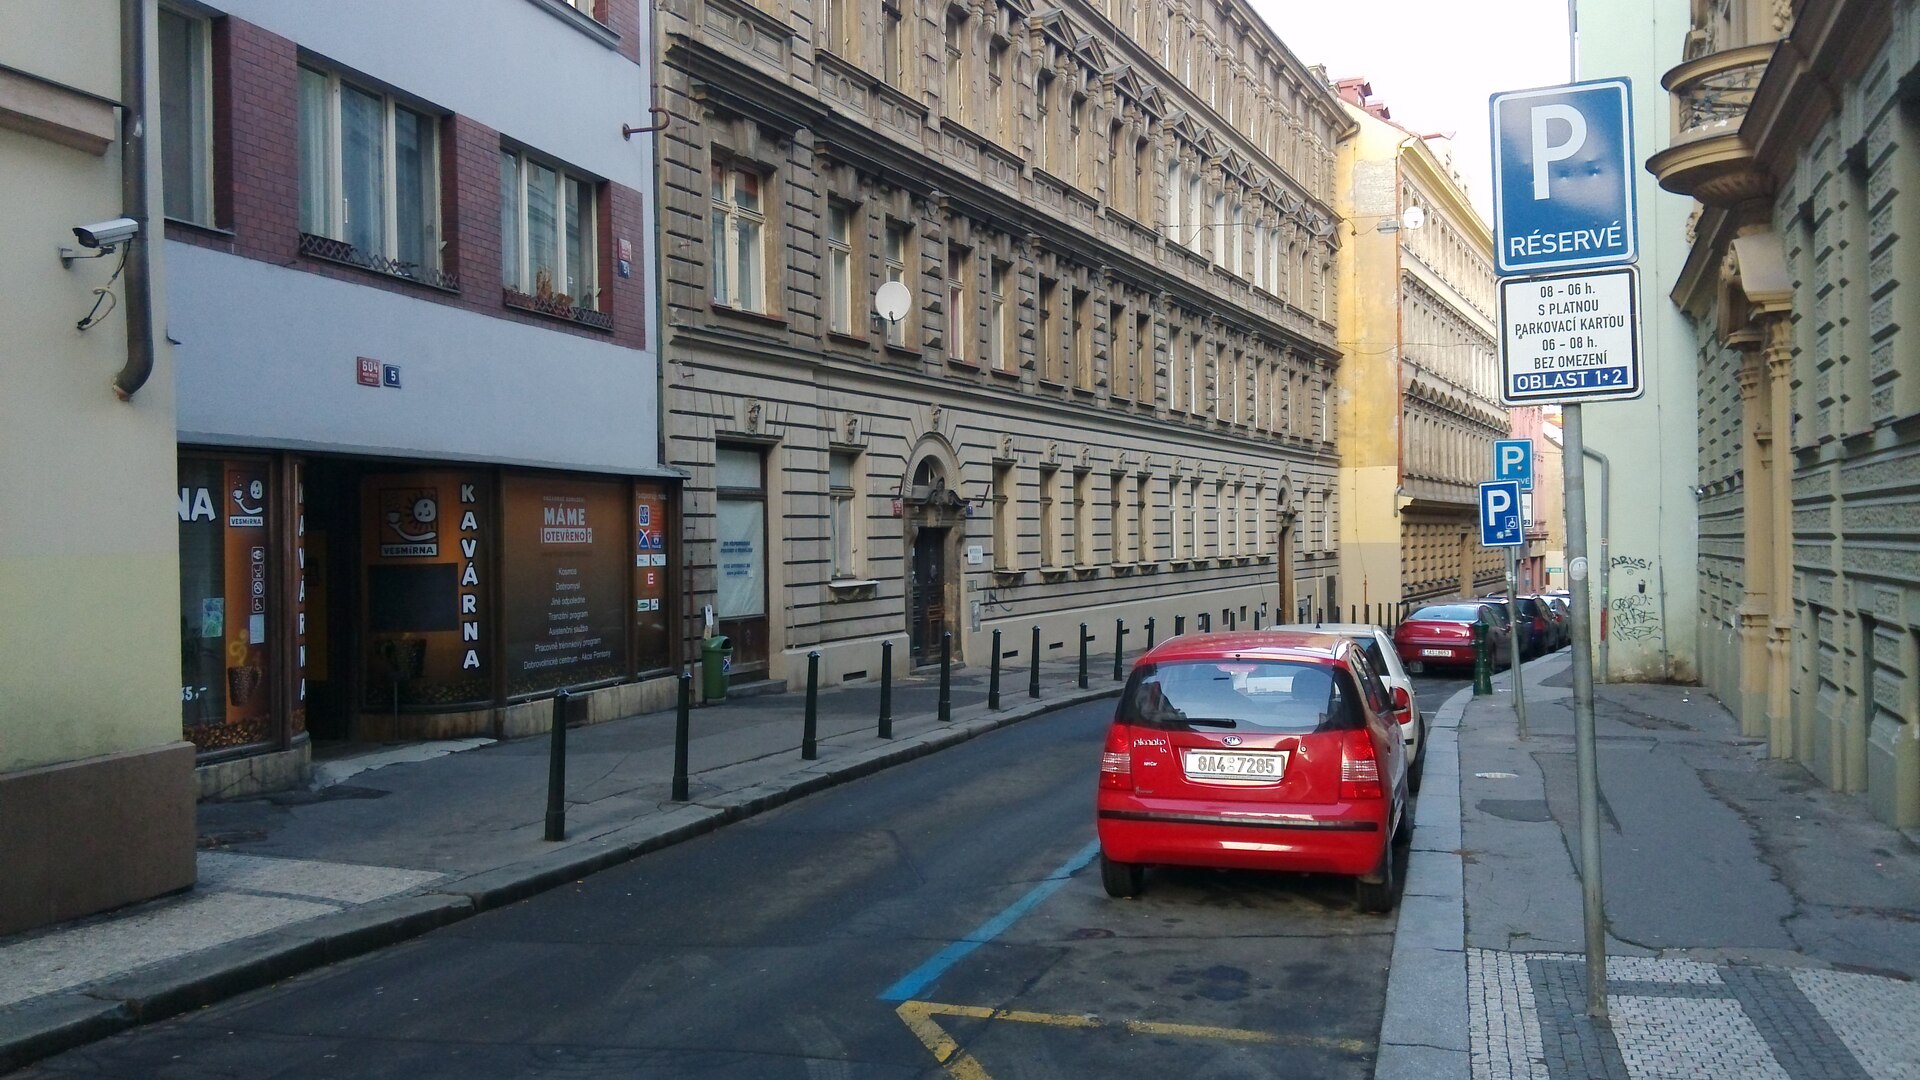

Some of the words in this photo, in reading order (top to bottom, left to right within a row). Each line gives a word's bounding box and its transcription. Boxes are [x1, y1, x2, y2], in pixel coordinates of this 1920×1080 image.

[1531, 103, 1587, 201] P
[1510, 221, 1622, 257] RÉSERVÉ
[1540, 286, 1554, 298] 08
[1567, 283, 1581, 295] 06
[1585, 282, 1596, 294] h.
[1538, 304, 1545, 316] S
[1549, 299, 1599, 315] PLATNOU
[1515, 317, 1577, 336] PARKOVACÍ
[1580, 315, 1624, 331] KARTOU
[1542, 338, 1555, 351] 06
[1569, 337, 1583, 349] 08
[1587, 336, 1598, 348] h.
[362, 360, 378, 373] 604
[1534, 357, 1554, 370] BEZ
[1558, 350, 1607, 368] OMEZENÍ
[390, 370, 397, 382] 5
[1517, 371, 1588, 390] OBLAST
[1501, 445, 1525, 475] P
[544, 503, 586, 526] MÁME
[1487, 489, 1511, 527] P
[460, 484, 480, 669] KAVÁRNA
[1198, 756, 1225, 772] 8A4
[1237, 757, 1275, 774] 7285
